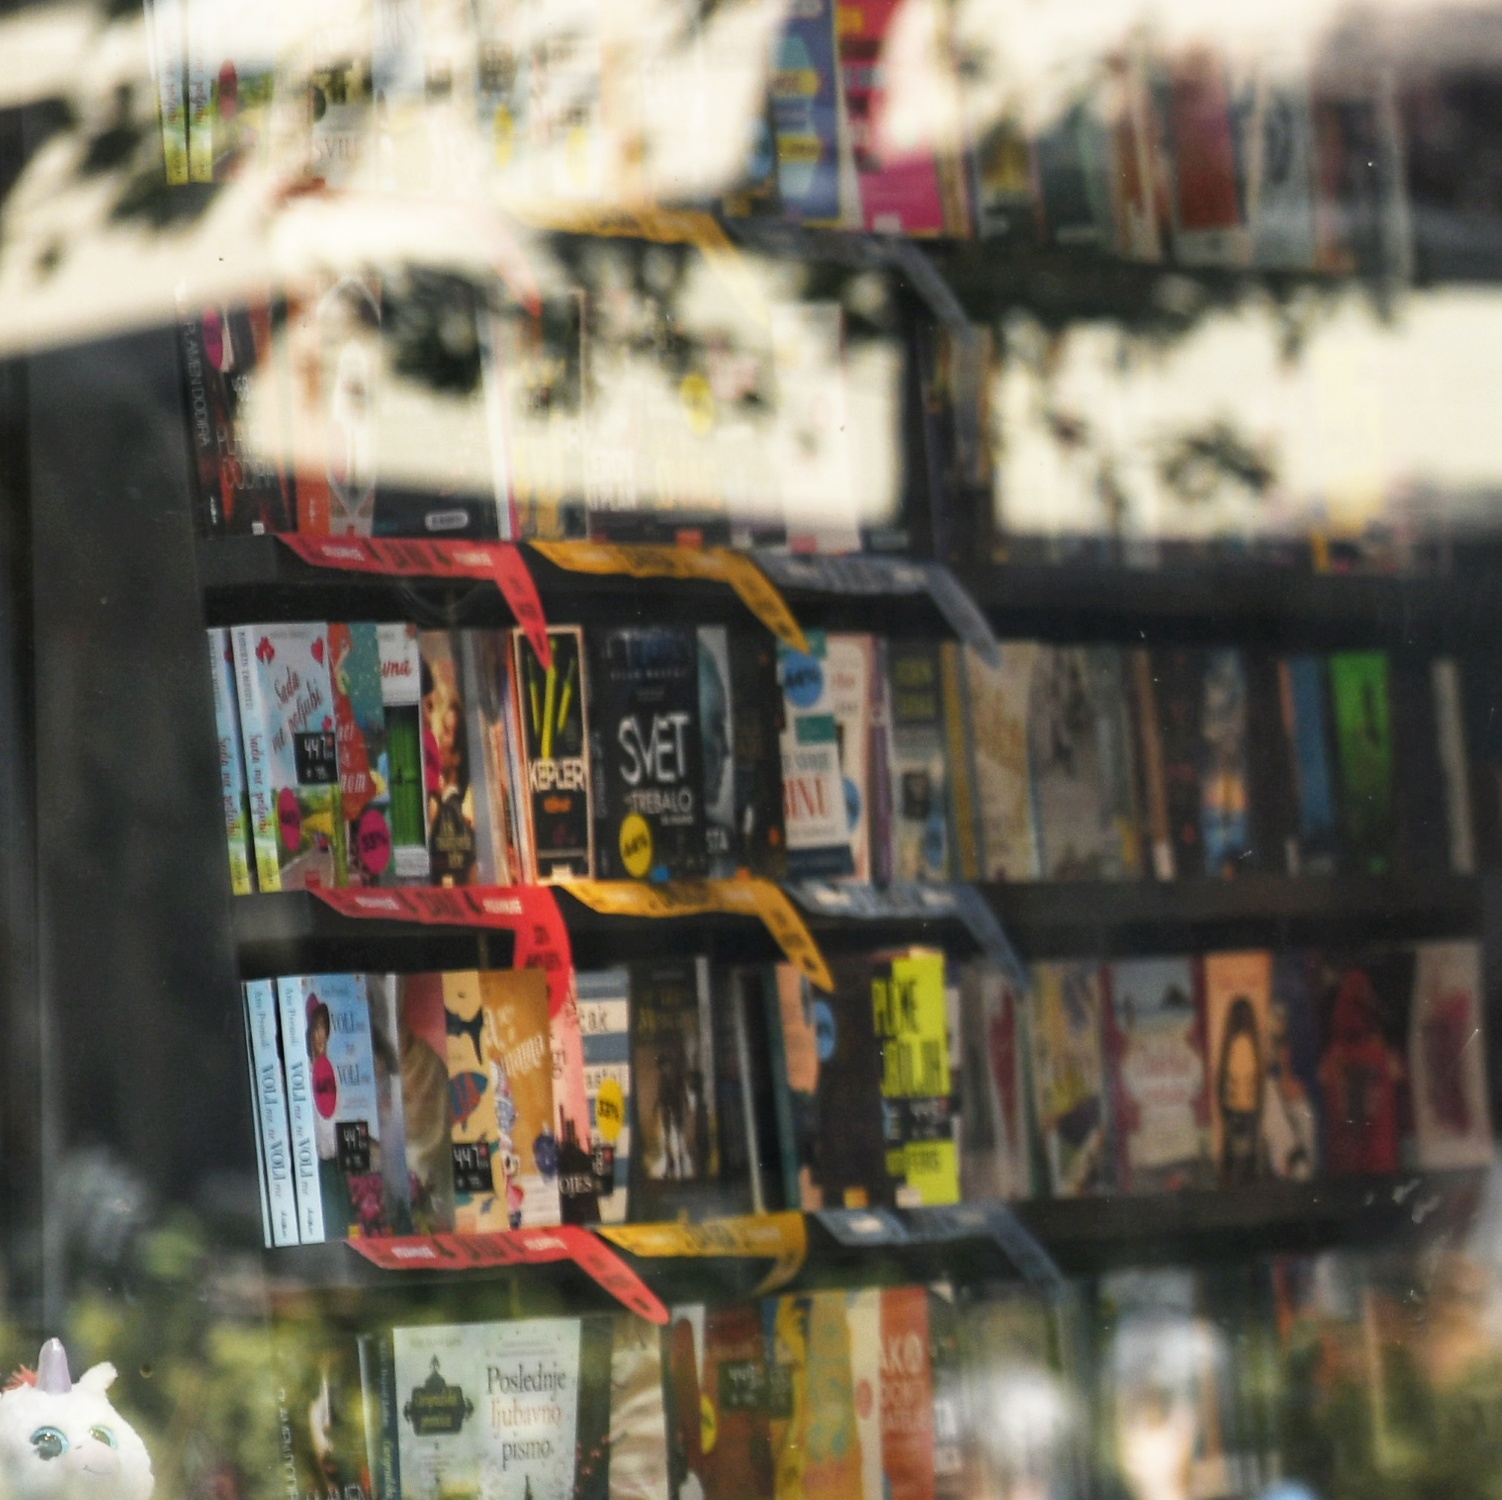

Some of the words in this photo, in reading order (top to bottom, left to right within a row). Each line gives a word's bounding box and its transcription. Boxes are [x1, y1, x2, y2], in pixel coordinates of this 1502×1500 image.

[617, 710, 691, 785] SVET
[486, 1359, 567, 1396] Poslednje
[490, 1397, 564, 1434] ljubavno
[502, 1437, 554, 1471] pismo
